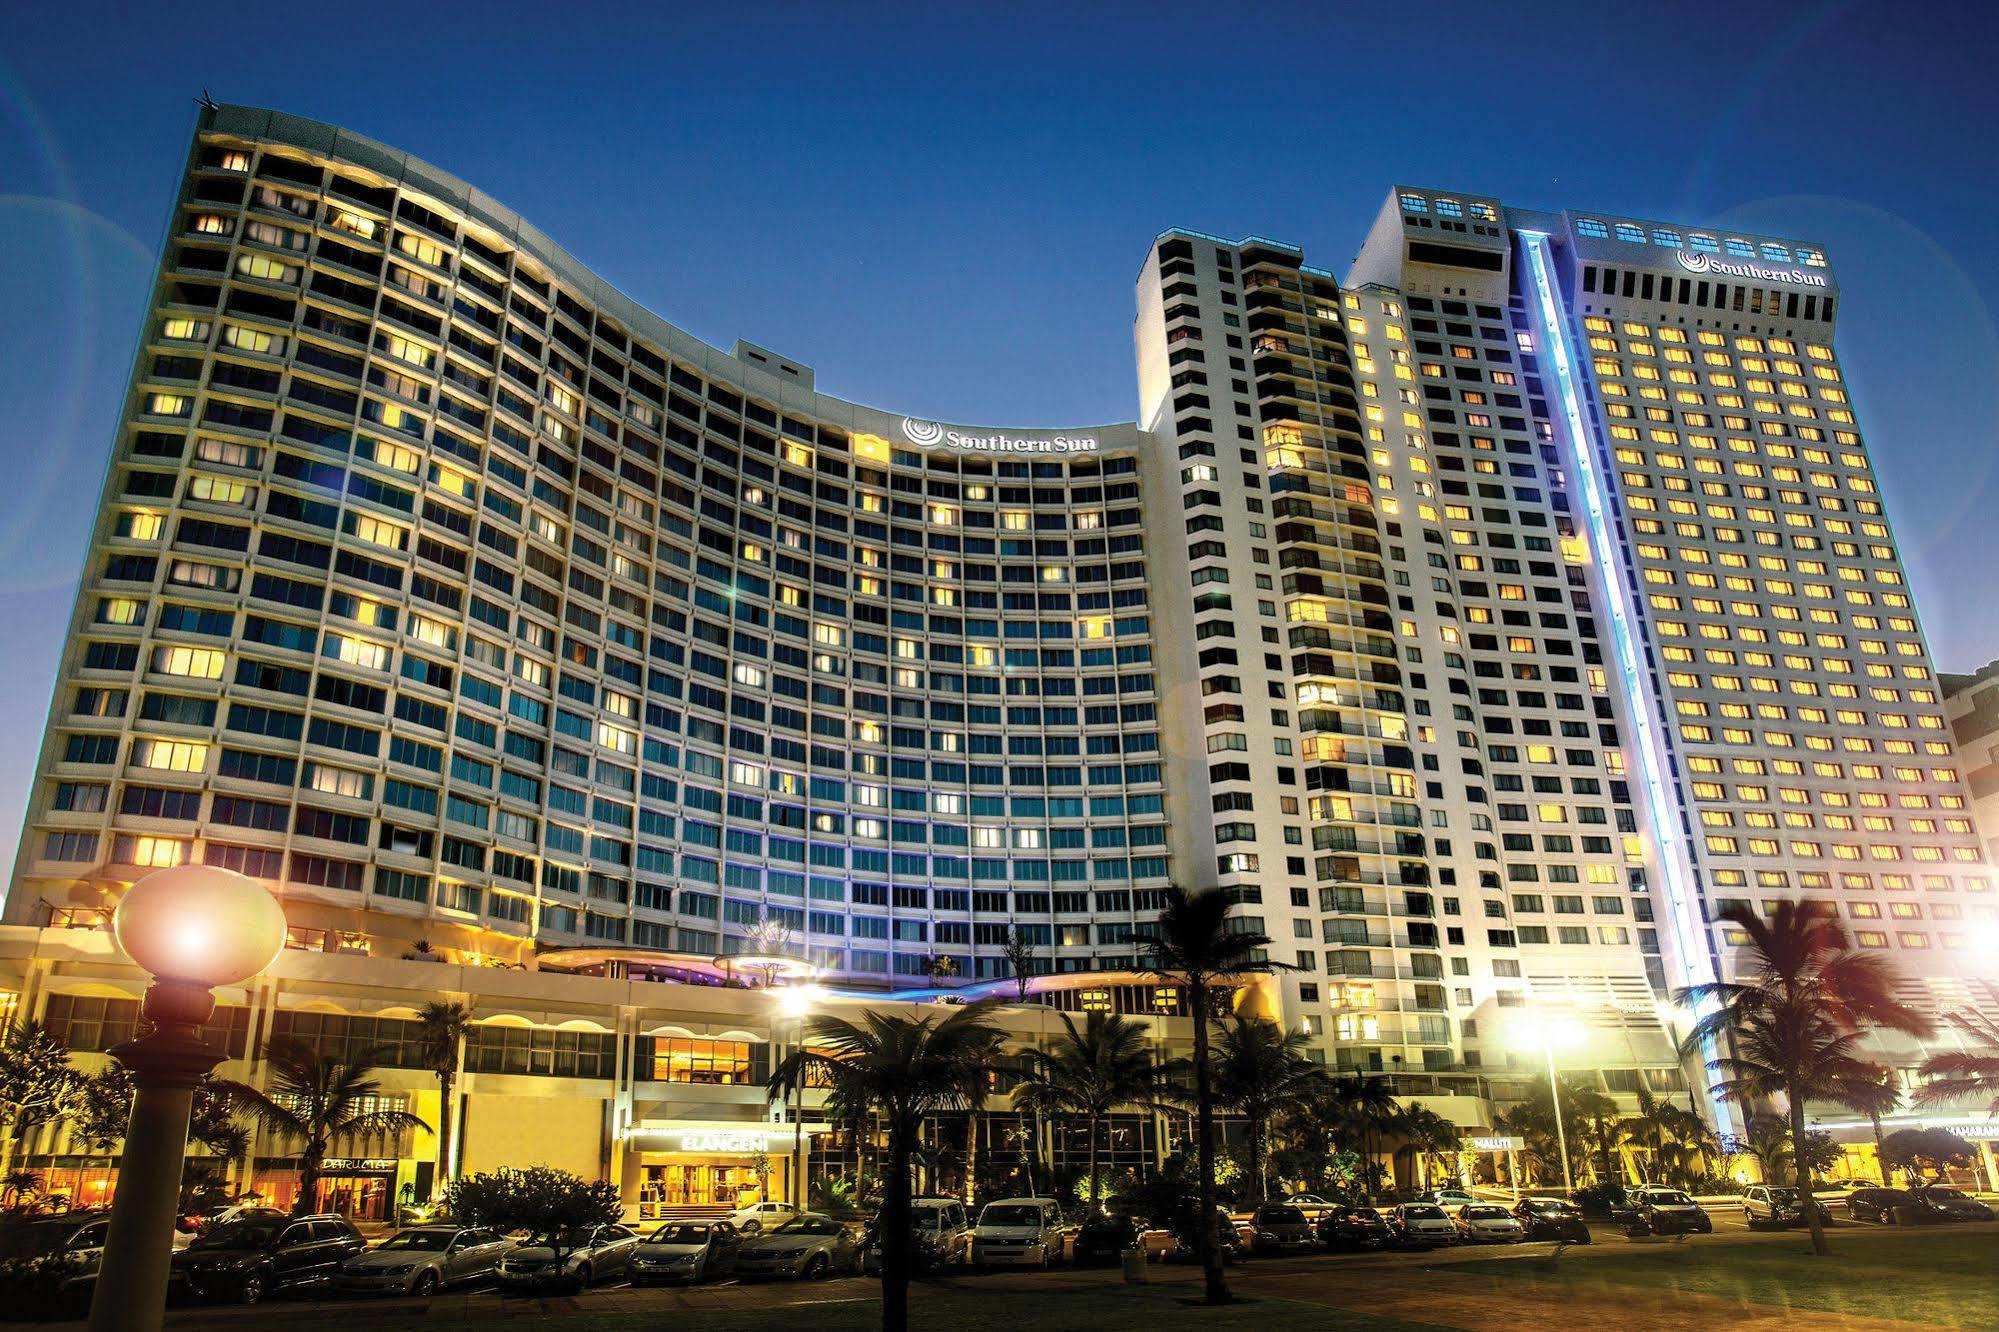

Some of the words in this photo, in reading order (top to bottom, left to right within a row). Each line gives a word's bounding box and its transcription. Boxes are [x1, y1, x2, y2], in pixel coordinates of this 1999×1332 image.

[1709, 260, 1792, 284] Southern
[1792, 269, 1826, 287] Sun
[946, 431, 1052, 453] Southern
[1054, 436, 1097, 452] Sun
[322, 1159, 388, 1170] DARUMA
